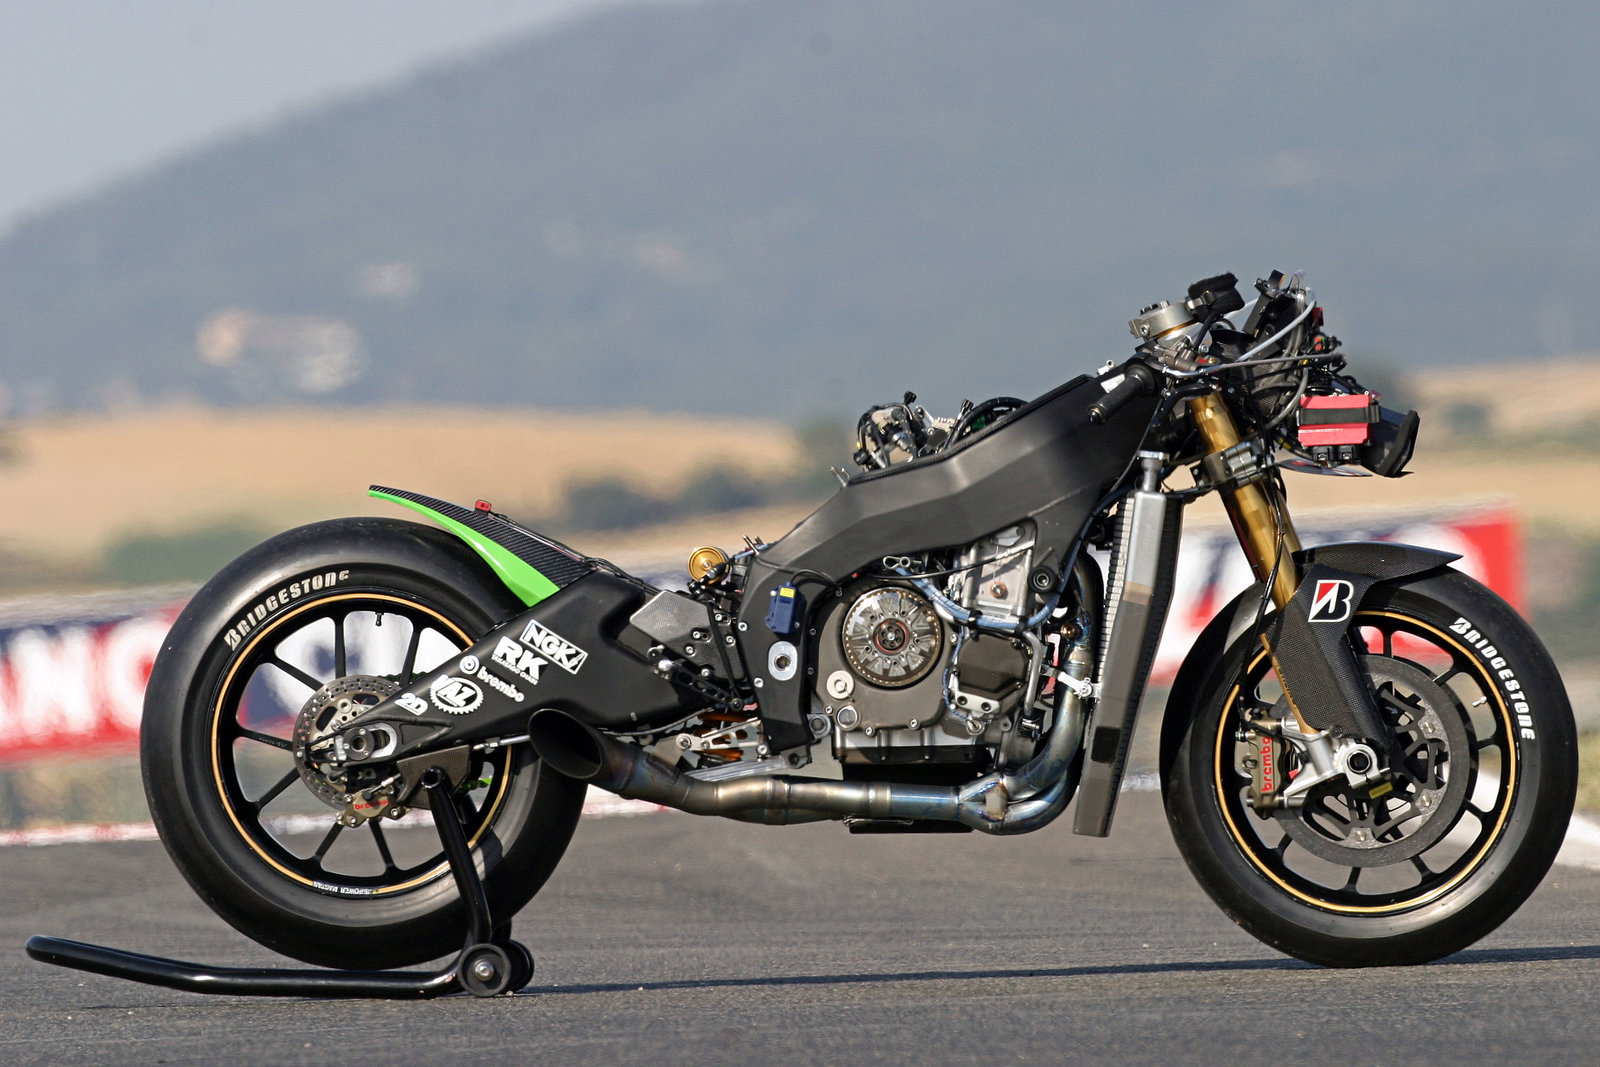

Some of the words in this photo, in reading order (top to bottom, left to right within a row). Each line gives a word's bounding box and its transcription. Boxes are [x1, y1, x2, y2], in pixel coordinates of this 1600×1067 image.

[493, 635, 548, 680] RK
[524, 624, 577, 668] NGK
[477, 665, 525, 702] brembo
[1449, 617, 1535, 740] BRIDGESTONE
[394, 692, 428, 716] 2D
[1260, 736, 1273, 792] brembo
